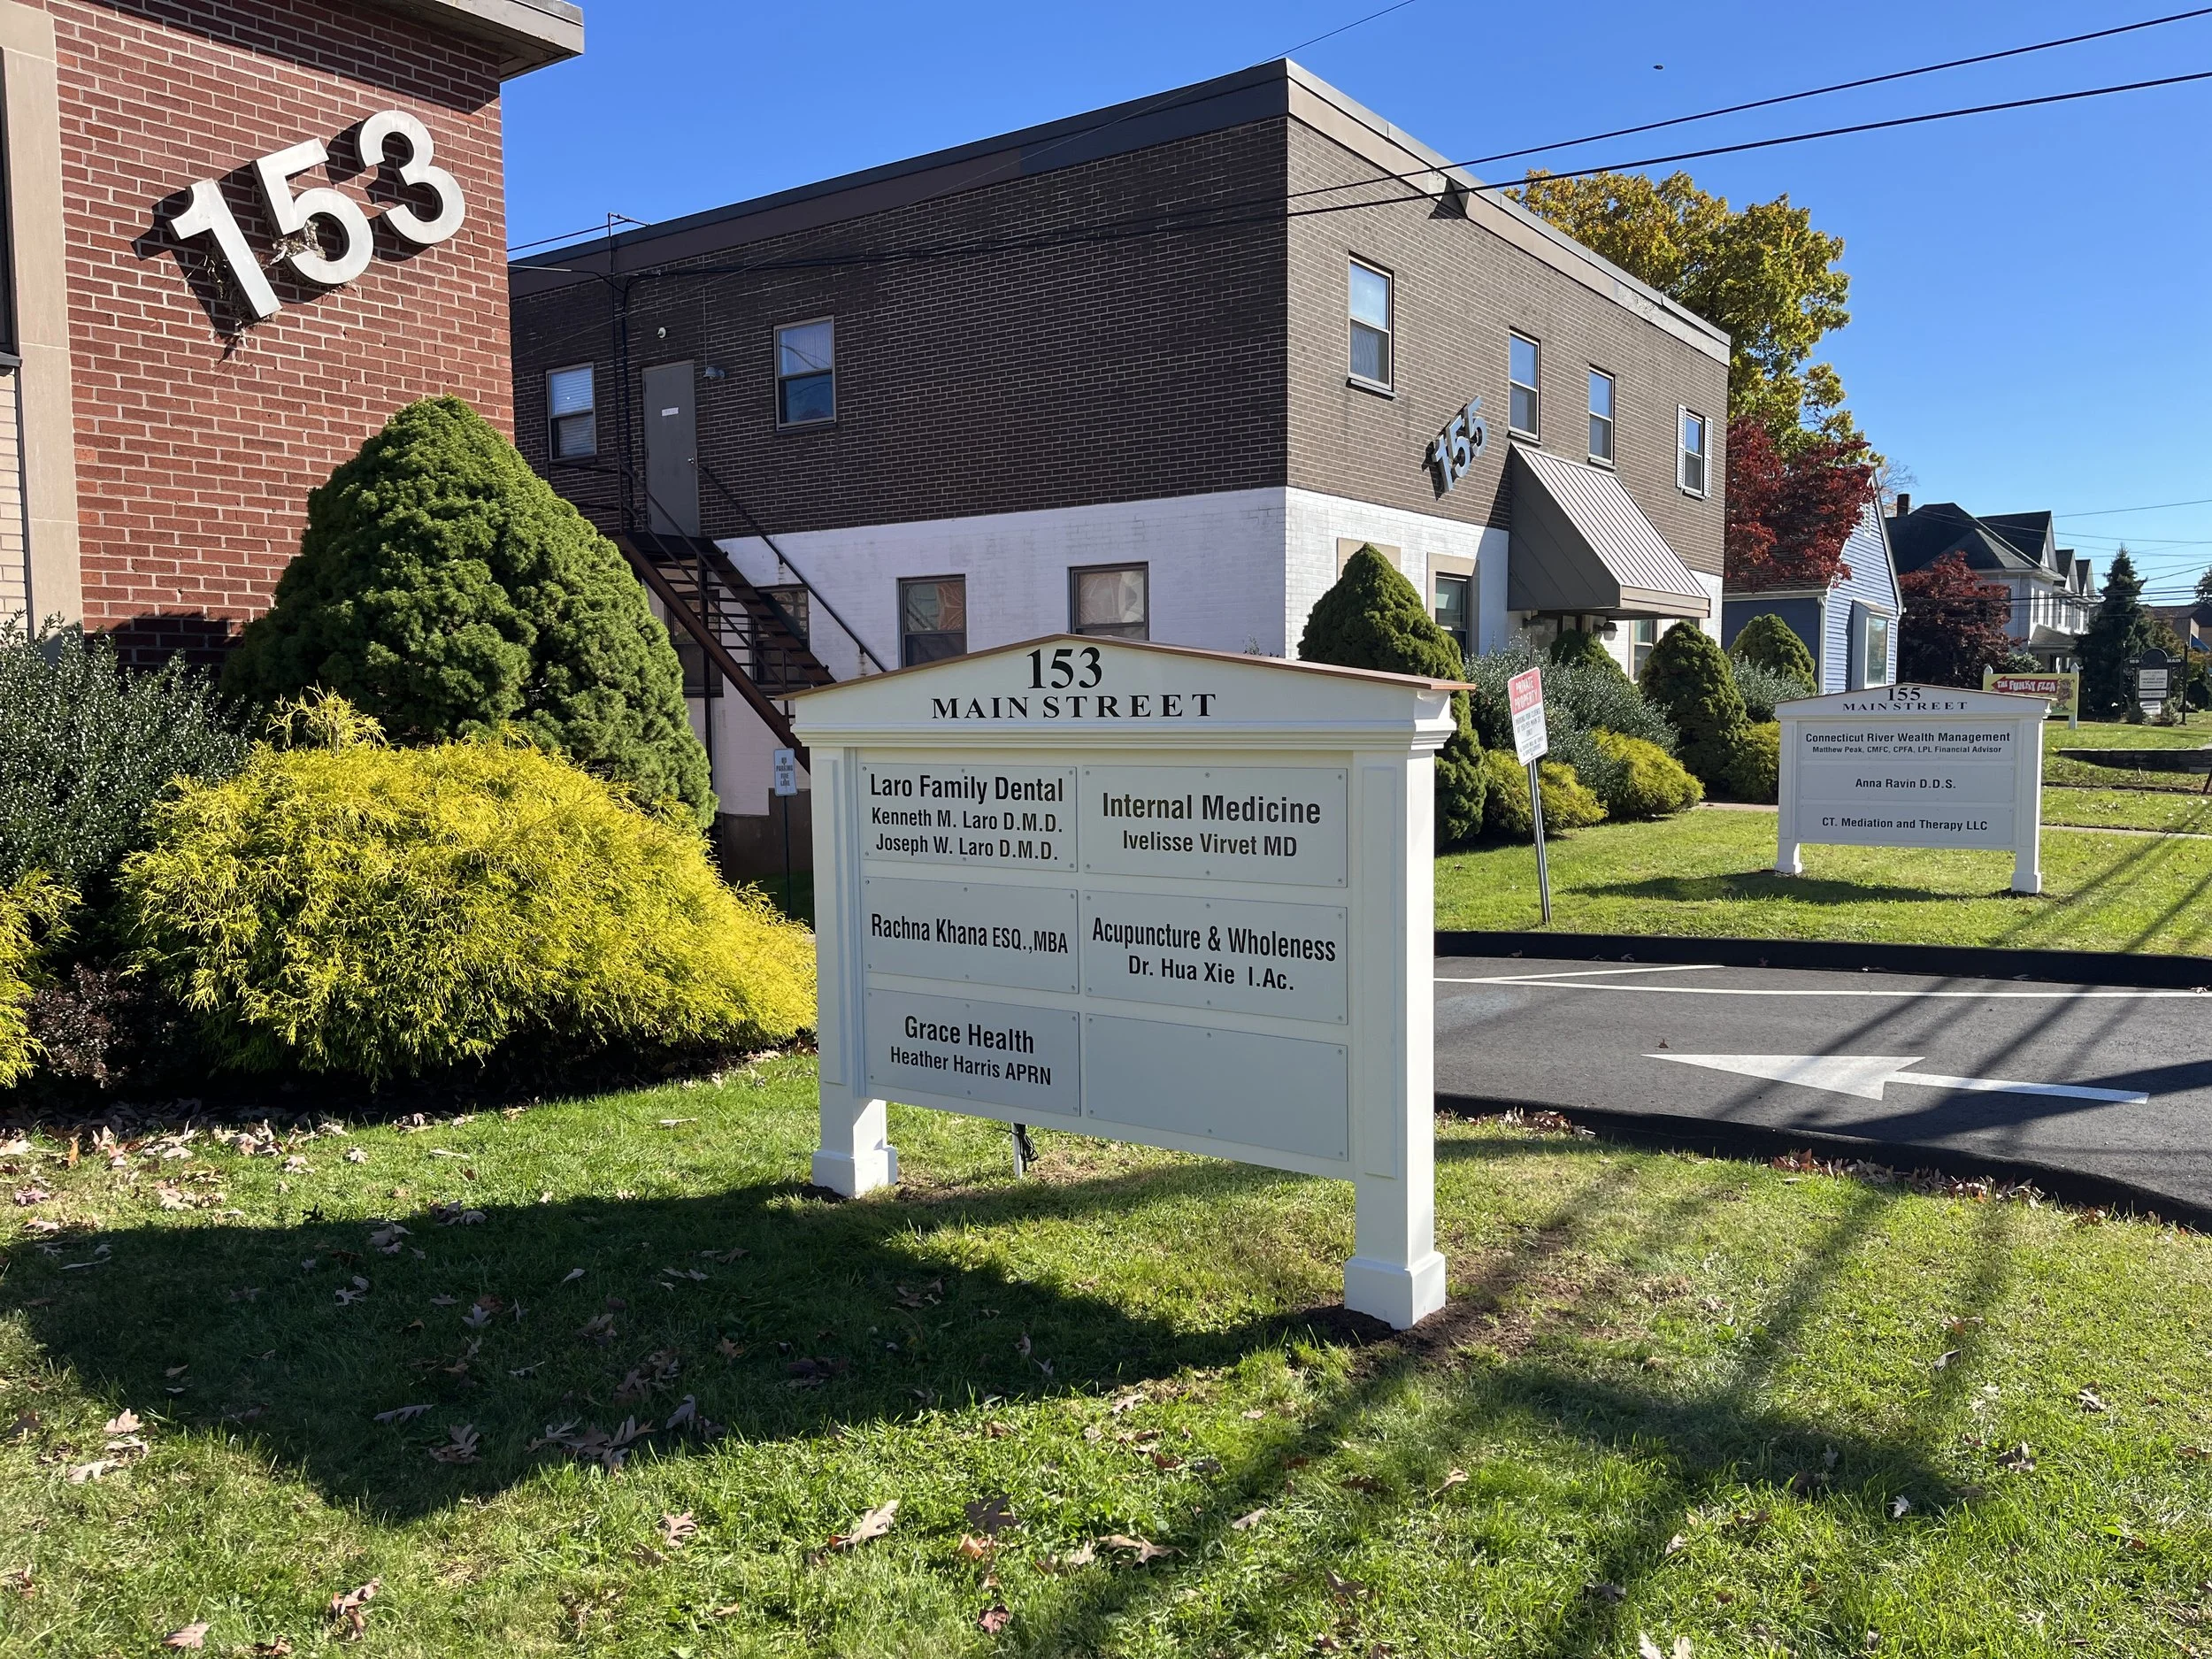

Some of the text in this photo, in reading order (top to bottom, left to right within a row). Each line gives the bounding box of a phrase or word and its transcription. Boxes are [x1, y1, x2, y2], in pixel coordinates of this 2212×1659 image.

[169, 110, 465, 319] 153
[1434, 396, 1487, 491] 155
[1026, 647, 1102, 689] 153
[1515, 676, 1534, 695] PRIVATE
[1888, 687, 1921, 701] 155
[2008, 680, 2035, 691] FUNKY
[2037, 681, 2056, 692] FLEA
[931, 694, 1216, 718] MAIN STREET
[1514, 688, 1538, 710] PROPERTY
[1893, 702, 1967, 710] STREET
[1806, 733, 1863, 742] Connecticut
[1897, 733, 1934, 741] Wealth
[1938, 733, 2010, 743] Management
[871, 773, 1063, 804] Laro Family Dental
[1855, 779, 1955, 788] Anna Ravin D.D.S.
[872, 807, 1062, 833] Kenneth M. Laro D.M.D.
[1103, 793, 1320, 824] Internal Medicine
[1823, 817, 1987, 832] CT. Mediation and Therapy LLC
[876, 833, 1057, 860] Joseph W. Laro D.M.D.
[1124, 830, 1296, 856] Ivelisse Virvet MD
[872, 913, 930, 941] Rachna
[936, 918, 987, 946] Khana
[1093, 918, 1335, 962] Acupuncture & Wholeness
[1129, 955, 1153, 976] Dr.
[1162, 958, 1197, 980] Hua
[1204, 962, 1234, 984] Xie
[905, 1016, 1033, 1054] Grace Health
[891, 1046, 1050, 1086] Heather Harris APRN
